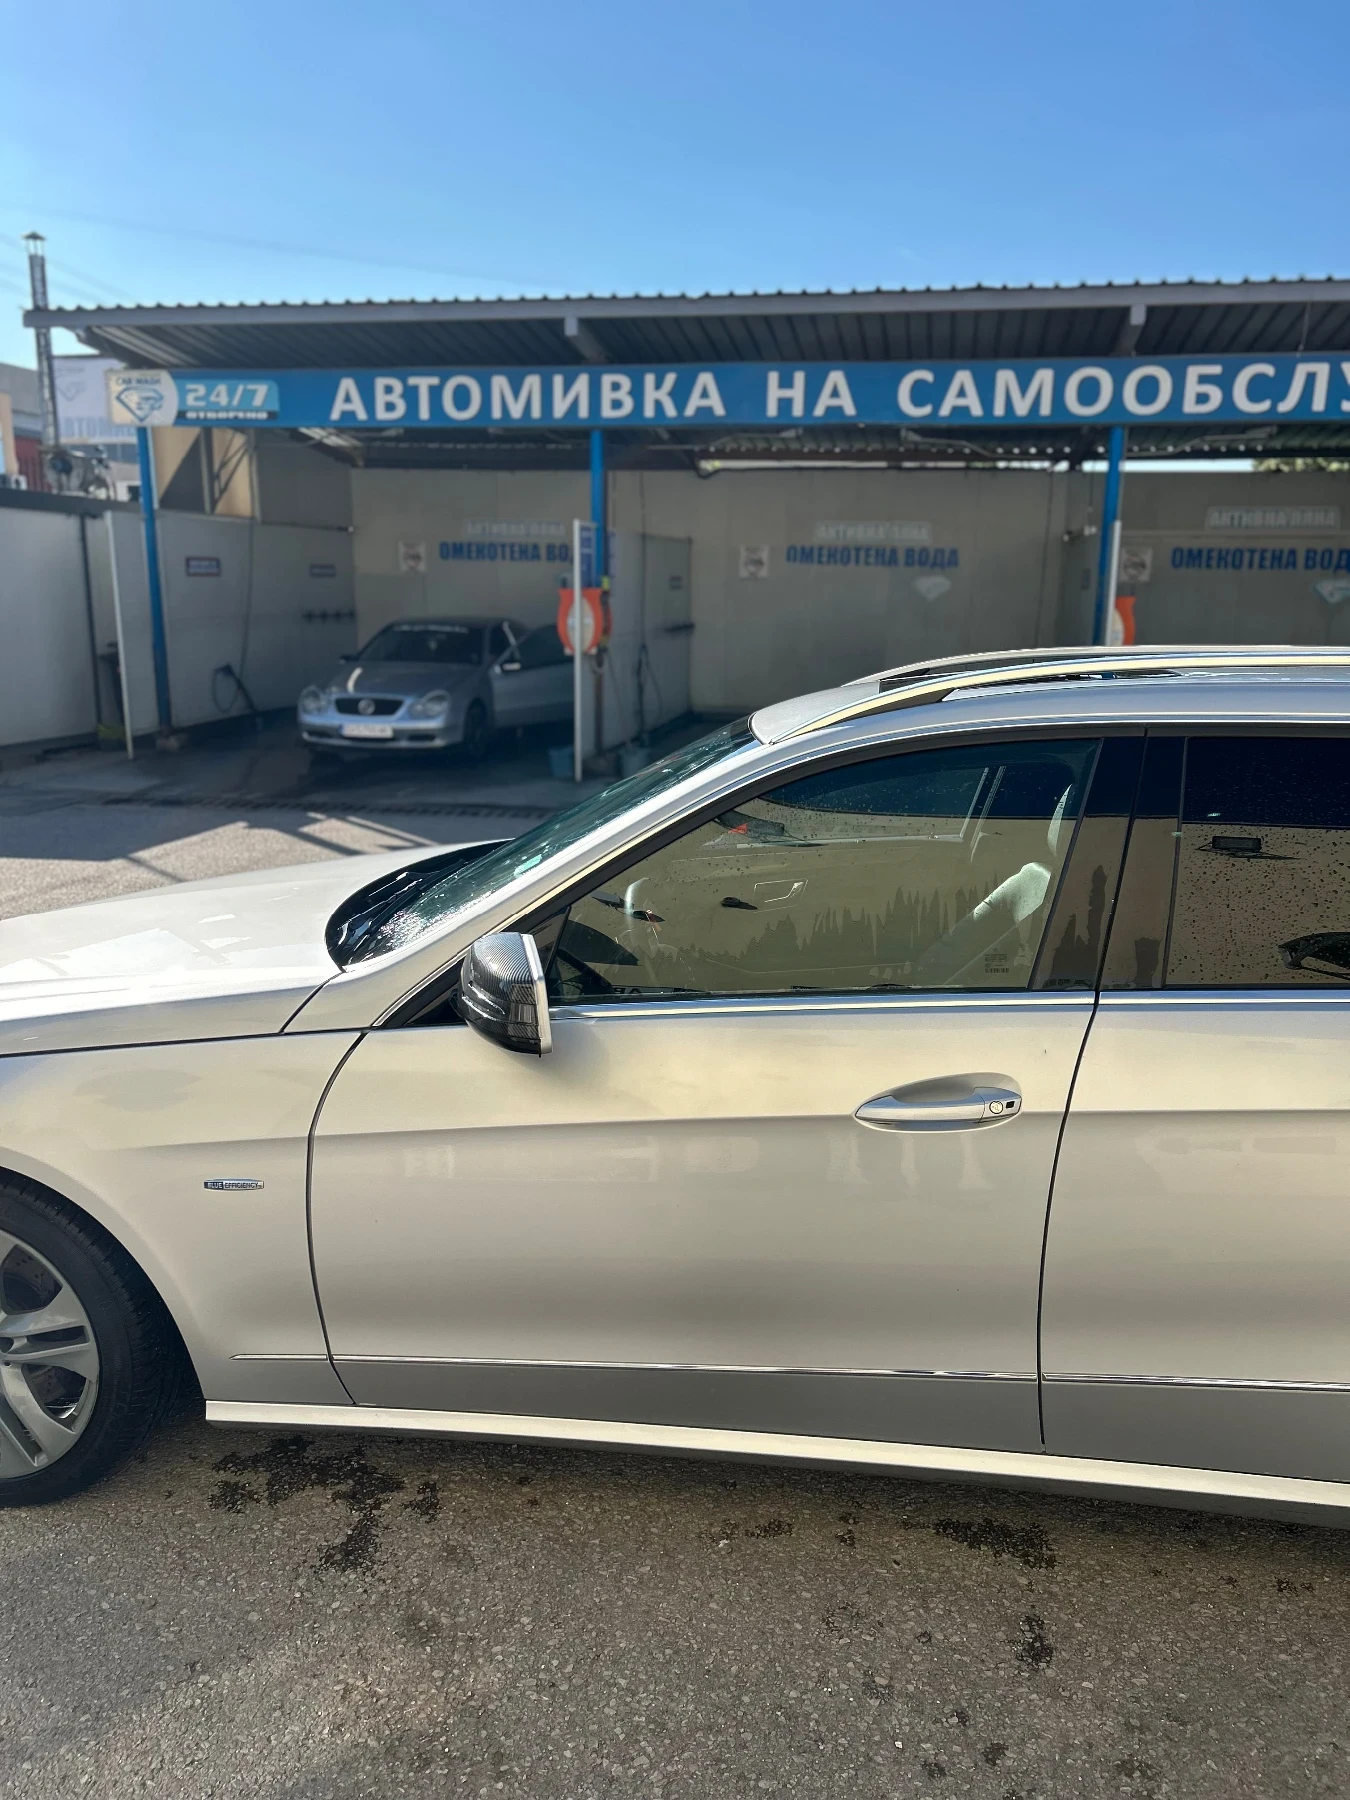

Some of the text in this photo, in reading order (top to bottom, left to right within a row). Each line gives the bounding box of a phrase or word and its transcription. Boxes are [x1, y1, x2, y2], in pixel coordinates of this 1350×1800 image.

[185, 383, 270, 407] 24/7
[329, 362, 1350, 421] АВТОМИВКА НА САМООБСЛ
[904, 547, 960, 570] ВОДА
